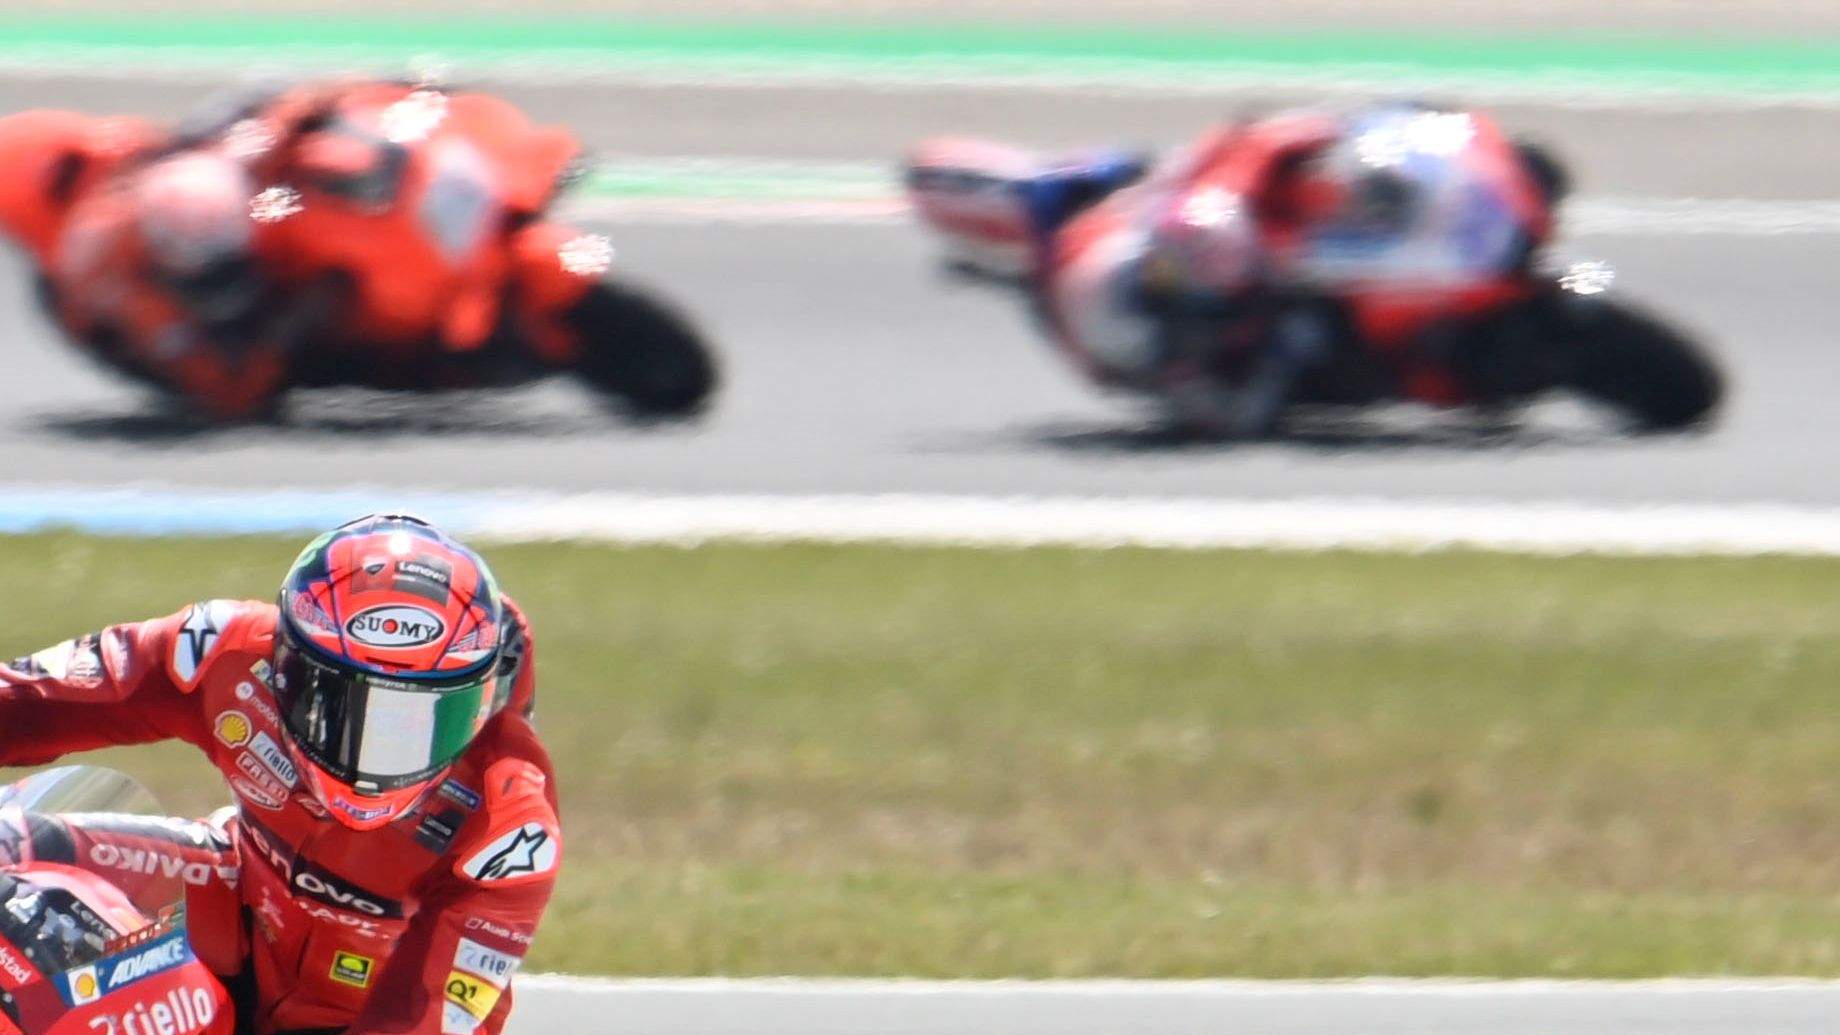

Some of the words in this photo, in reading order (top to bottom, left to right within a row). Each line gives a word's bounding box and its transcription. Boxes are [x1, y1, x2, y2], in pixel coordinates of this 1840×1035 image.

[354, 614, 437, 640] SUOMY
[243, 818, 385, 915] enovo
[108, 936, 185, 989] ADVANCE
